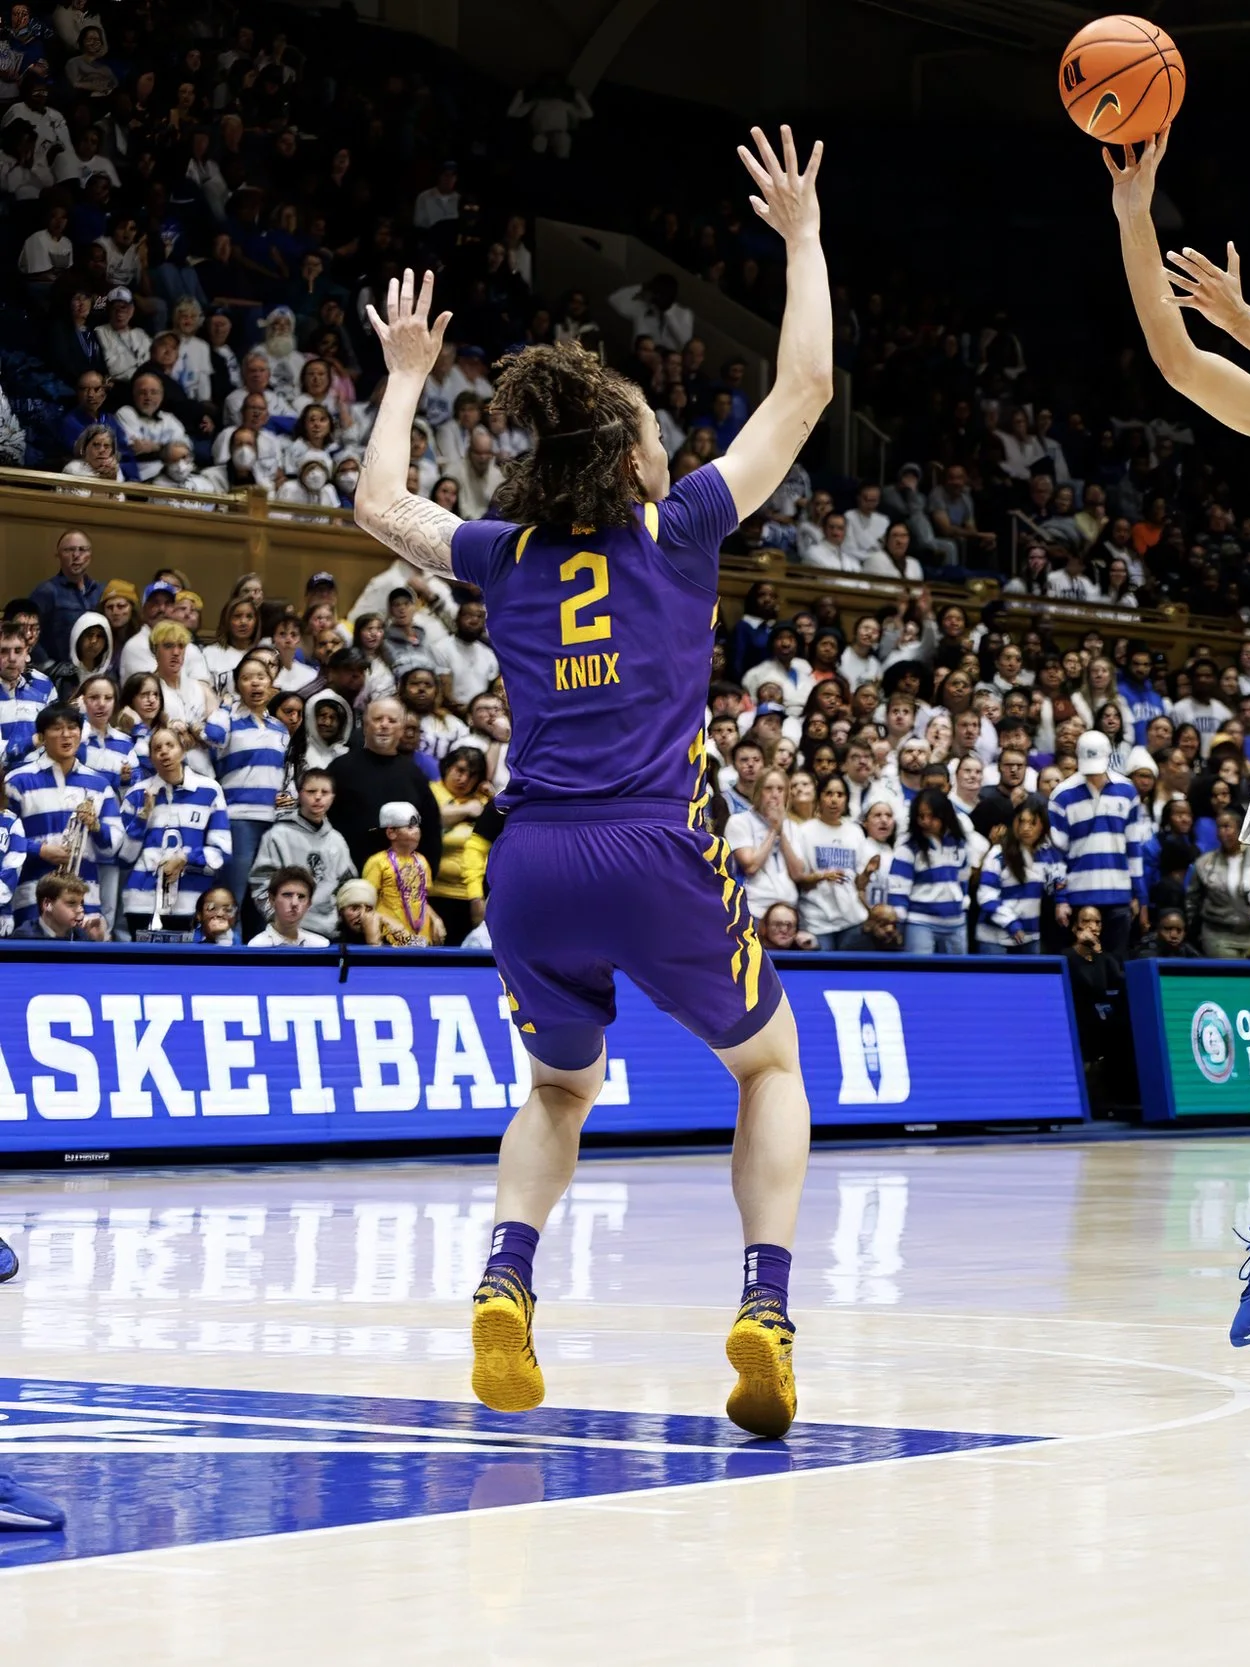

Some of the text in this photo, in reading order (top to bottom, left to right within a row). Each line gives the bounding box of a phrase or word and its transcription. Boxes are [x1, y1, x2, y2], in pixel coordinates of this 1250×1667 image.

[559, 551, 612, 646] 2
[554, 652, 620, 691] KNOX
[0, 993, 631, 1122] SKETBA
[823, 990, 911, 1105] D
